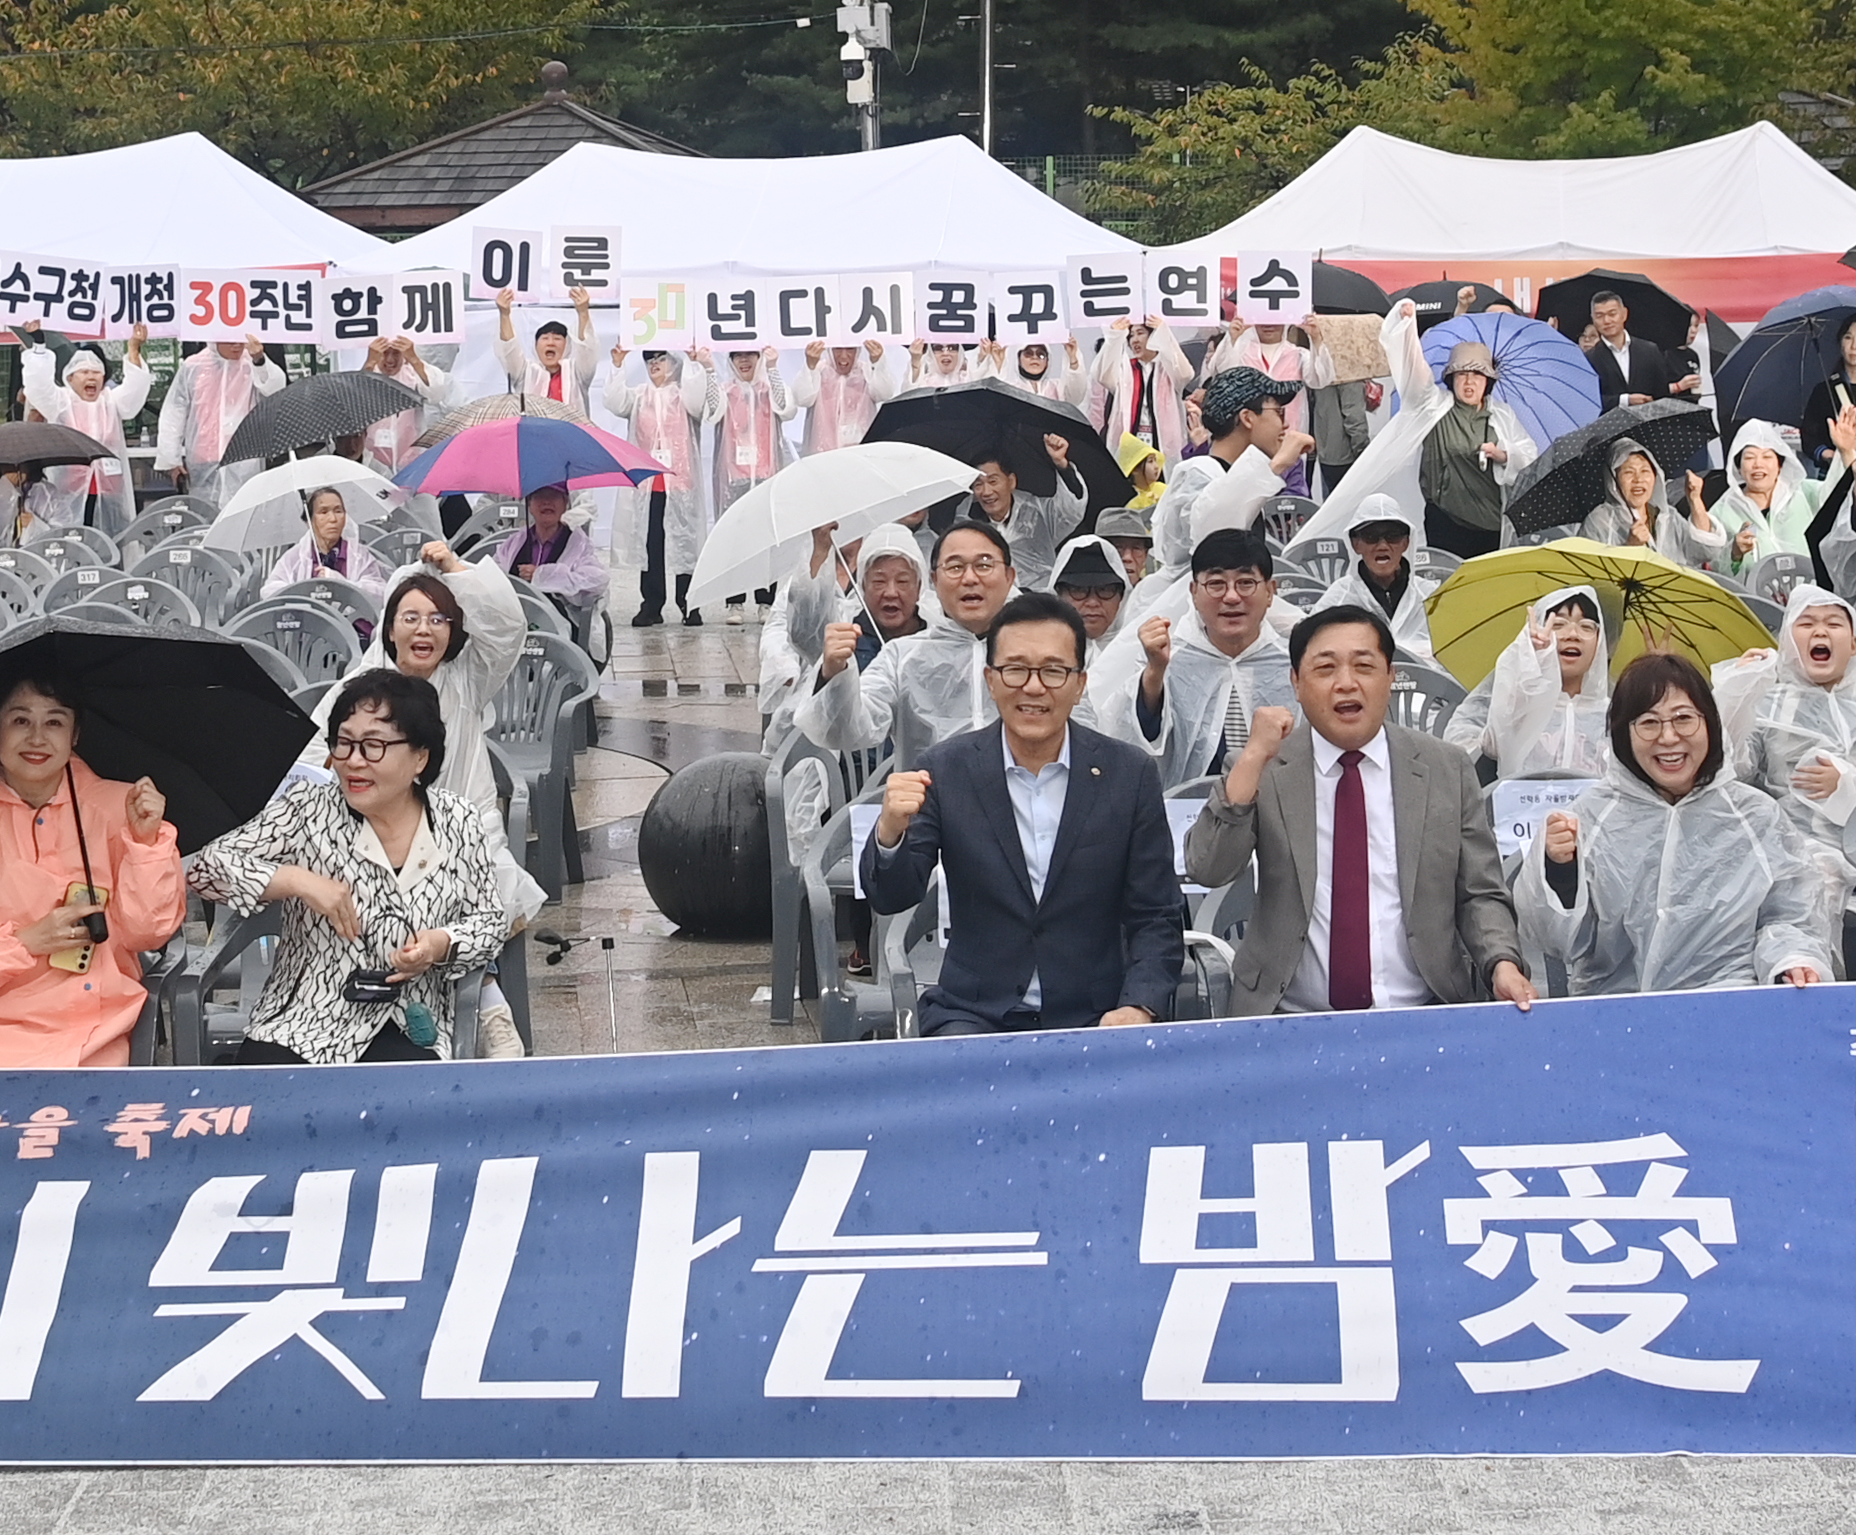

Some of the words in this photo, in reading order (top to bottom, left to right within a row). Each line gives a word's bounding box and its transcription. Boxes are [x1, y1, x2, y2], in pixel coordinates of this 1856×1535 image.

[110, 272, 176, 325] 개청
[187, 278, 314, 333] 30주년
[1319, 542, 1336, 552] 121
[102, 1102, 253, 1160] 축제
[136, 1149, 1049, 1402] 빛나는
